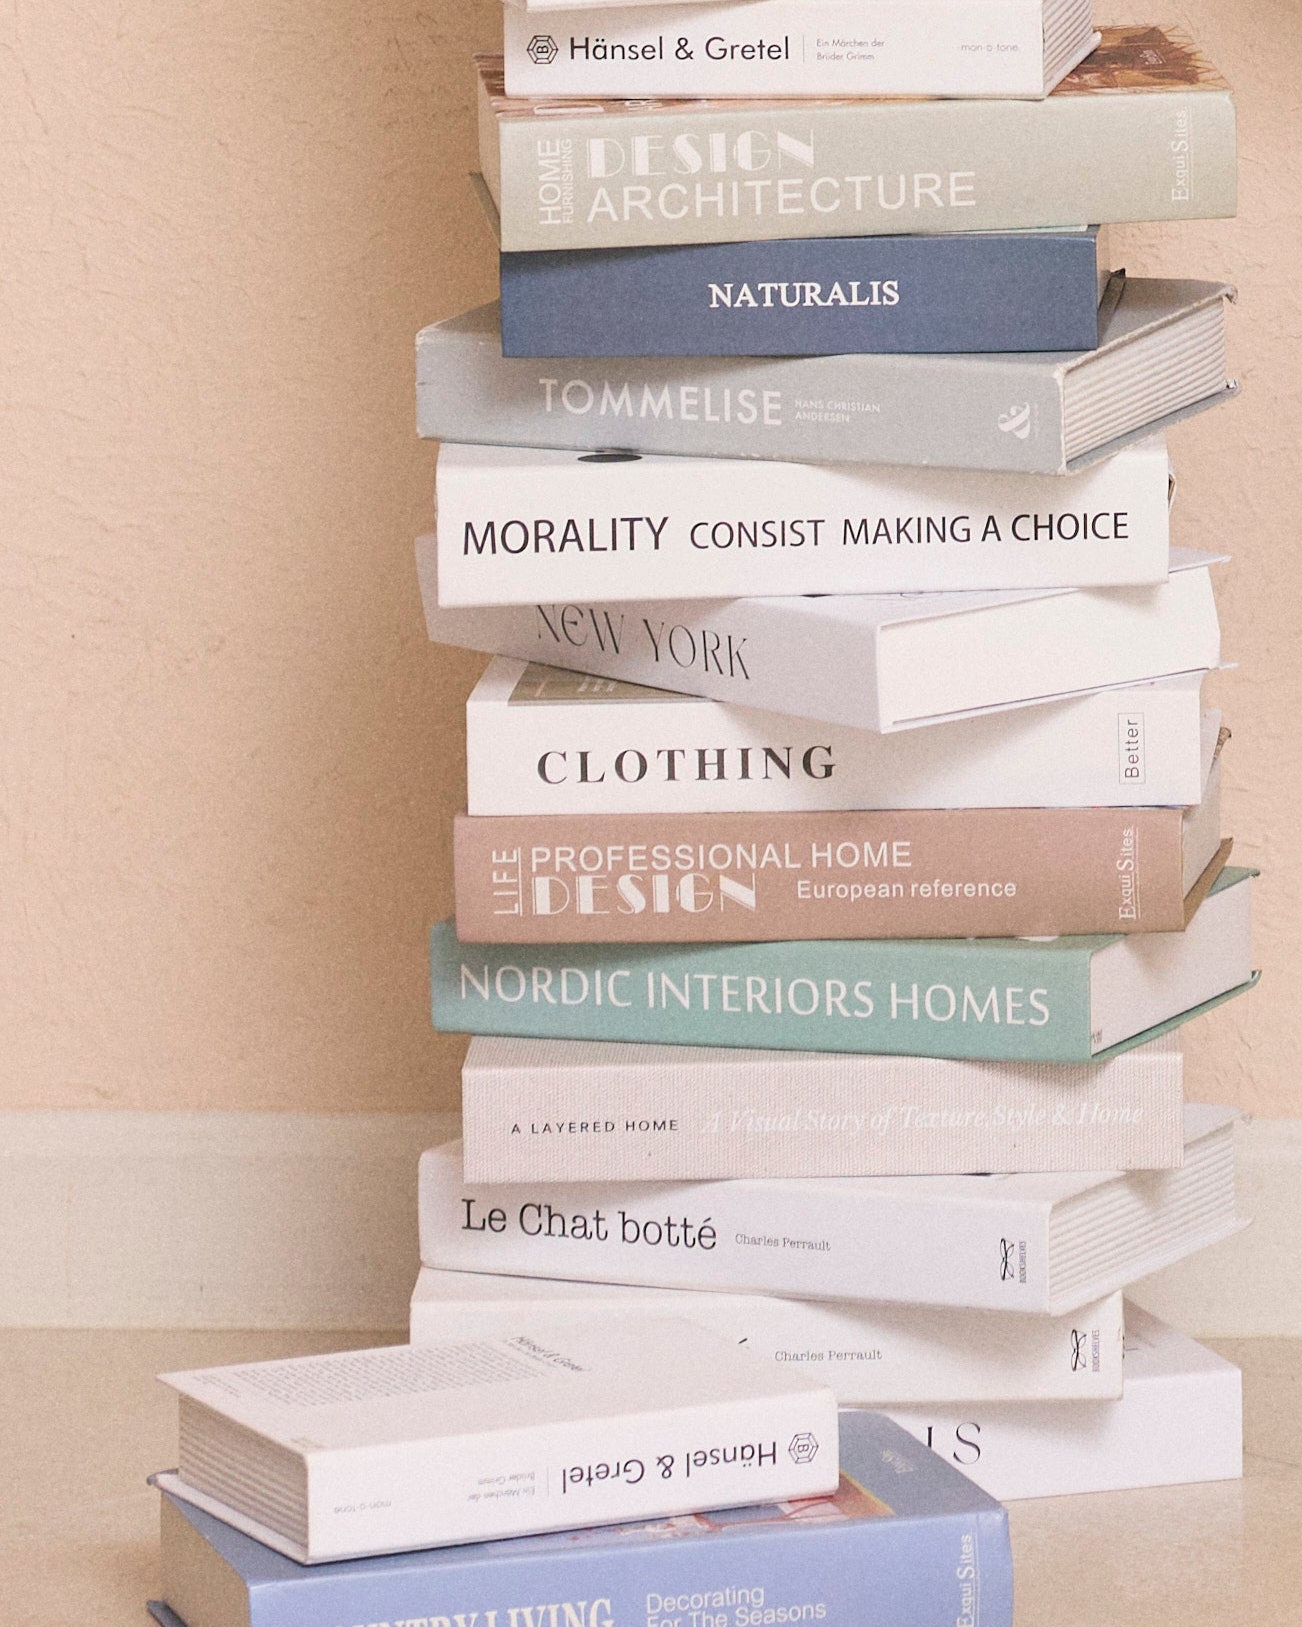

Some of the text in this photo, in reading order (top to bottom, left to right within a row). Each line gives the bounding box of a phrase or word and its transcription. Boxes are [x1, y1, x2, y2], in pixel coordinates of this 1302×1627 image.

[568, 36, 790, 62] Hänsel & Gretel
[586, 129, 815, 179] DESIGN
[538, 139, 562, 225] HOME
[561, 137, 575, 224] FURNISHING
[587, 171, 977, 223] ARCHITECTURE
[709, 280, 900, 309] NATURALIS
[538, 378, 784, 428] TOMMELISE
[795, 399, 824, 410] HANS
[463, 512, 1129, 556] MORALITY CONSIST MAKING A CHOICE
[536, 604, 750, 680] NEW YORK
[537, 745, 837, 786] CLOTHING
[1124, 719, 1140, 778] Better
[531, 841, 912, 872] PROFESSIONAL HOME
[492, 849, 520, 915] LIFE
[531, 872, 757, 916] DESIGN
[797, 879, 1016, 900] European reference
[460, 965, 1050, 1026] NORDIC INTERIORS HOMES
[511, 1119, 679, 1134] A LAYERED HOME
[461, 1199, 717, 1250] Le Chat botté
[735, 1233, 831, 1251] Charles Perrault
[774, 1348, 882, 1362] Charles Perrault
[562, 1441, 777, 1494] Hänsel & Gretel
[646, 1585, 765, 1614] Decorating
[688, 1611, 727, 1627] The
[735, 1602, 827, 1626] Seasons
